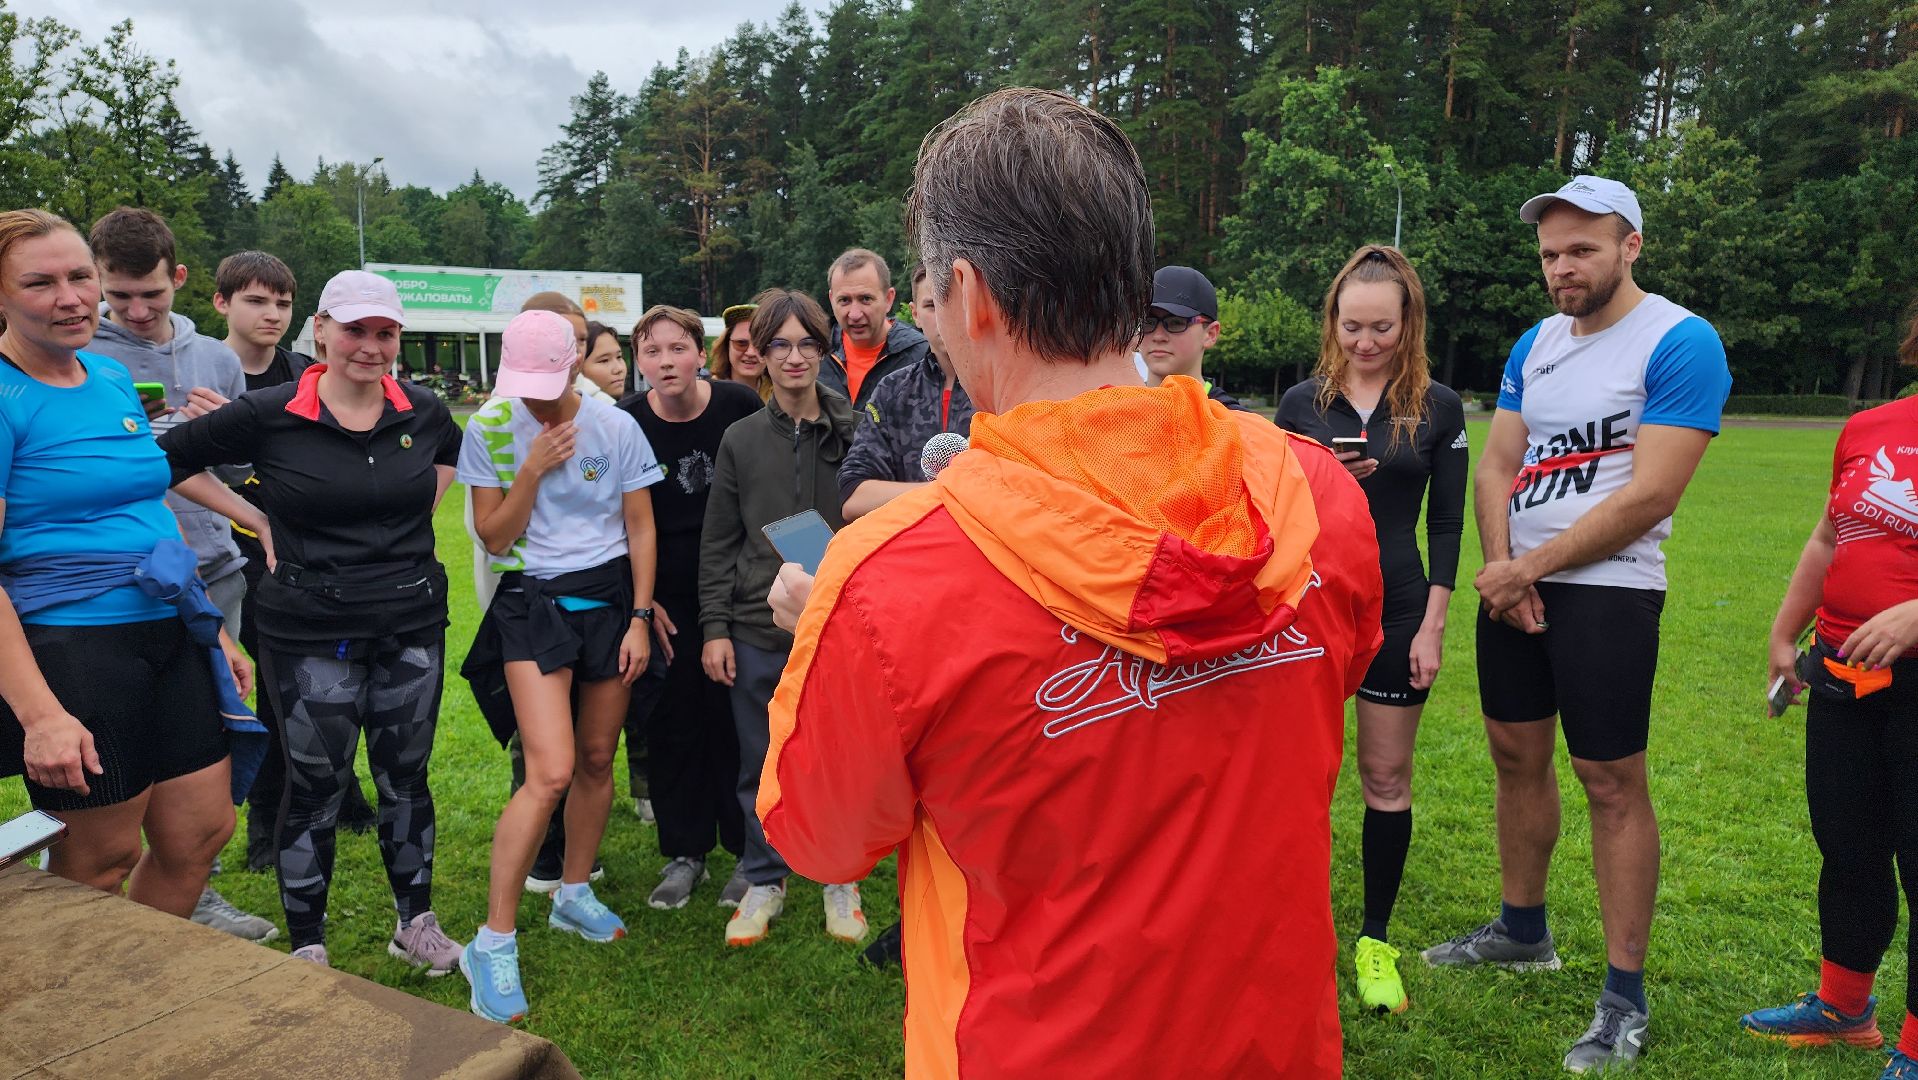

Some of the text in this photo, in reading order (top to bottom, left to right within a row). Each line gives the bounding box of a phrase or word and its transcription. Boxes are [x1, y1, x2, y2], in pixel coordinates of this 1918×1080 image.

[395, 280, 428, 290] ОБРО
[398, 292, 472, 304] ЖАЛОВАТЬ!
[1508, 456, 1600, 517] RUN
[1853, 501, 1882, 521] ODI
